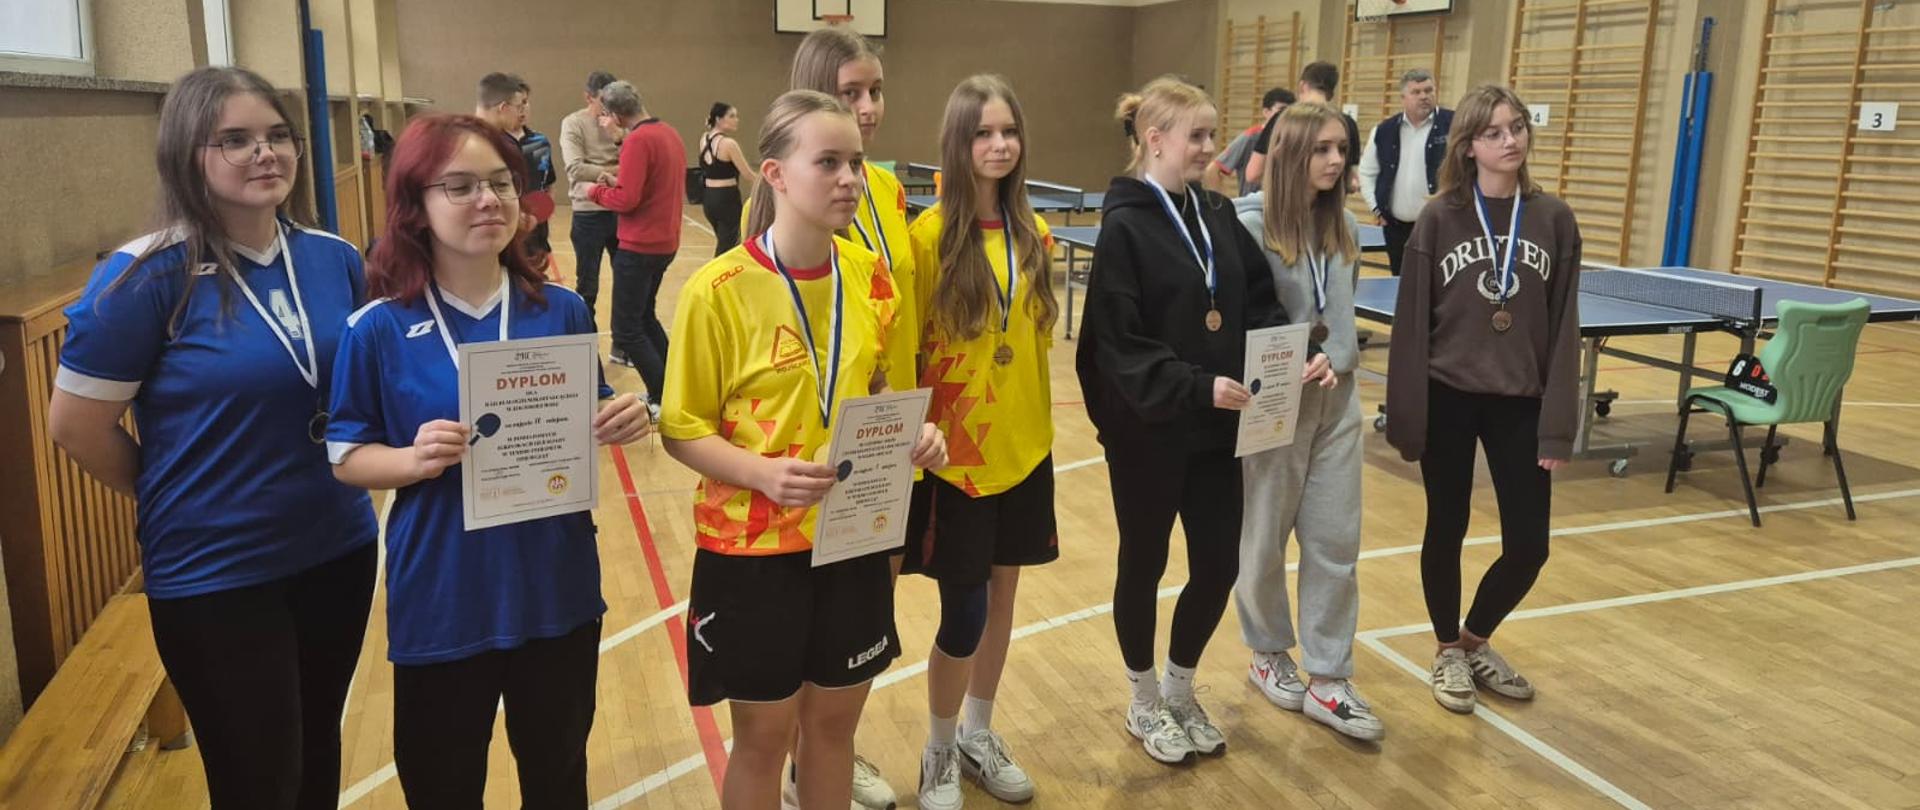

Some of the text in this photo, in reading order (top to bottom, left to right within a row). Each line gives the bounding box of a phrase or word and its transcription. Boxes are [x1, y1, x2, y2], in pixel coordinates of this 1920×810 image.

[1533, 111, 1541, 123] 4
[1871, 112, 1882, 129] 3
[1440, 235, 1551, 287] DRIED
[269, 289, 304, 340] 4
[1261, 350, 1294, 363] DYPLOM
[1732, 360, 1746, 376] 6
[1751, 364, 1762, 378] 0
[496, 372, 566, 390] DYPLOM
[856, 422, 904, 440] DYPLOM
[848, 635, 888, 669] LEGEA
